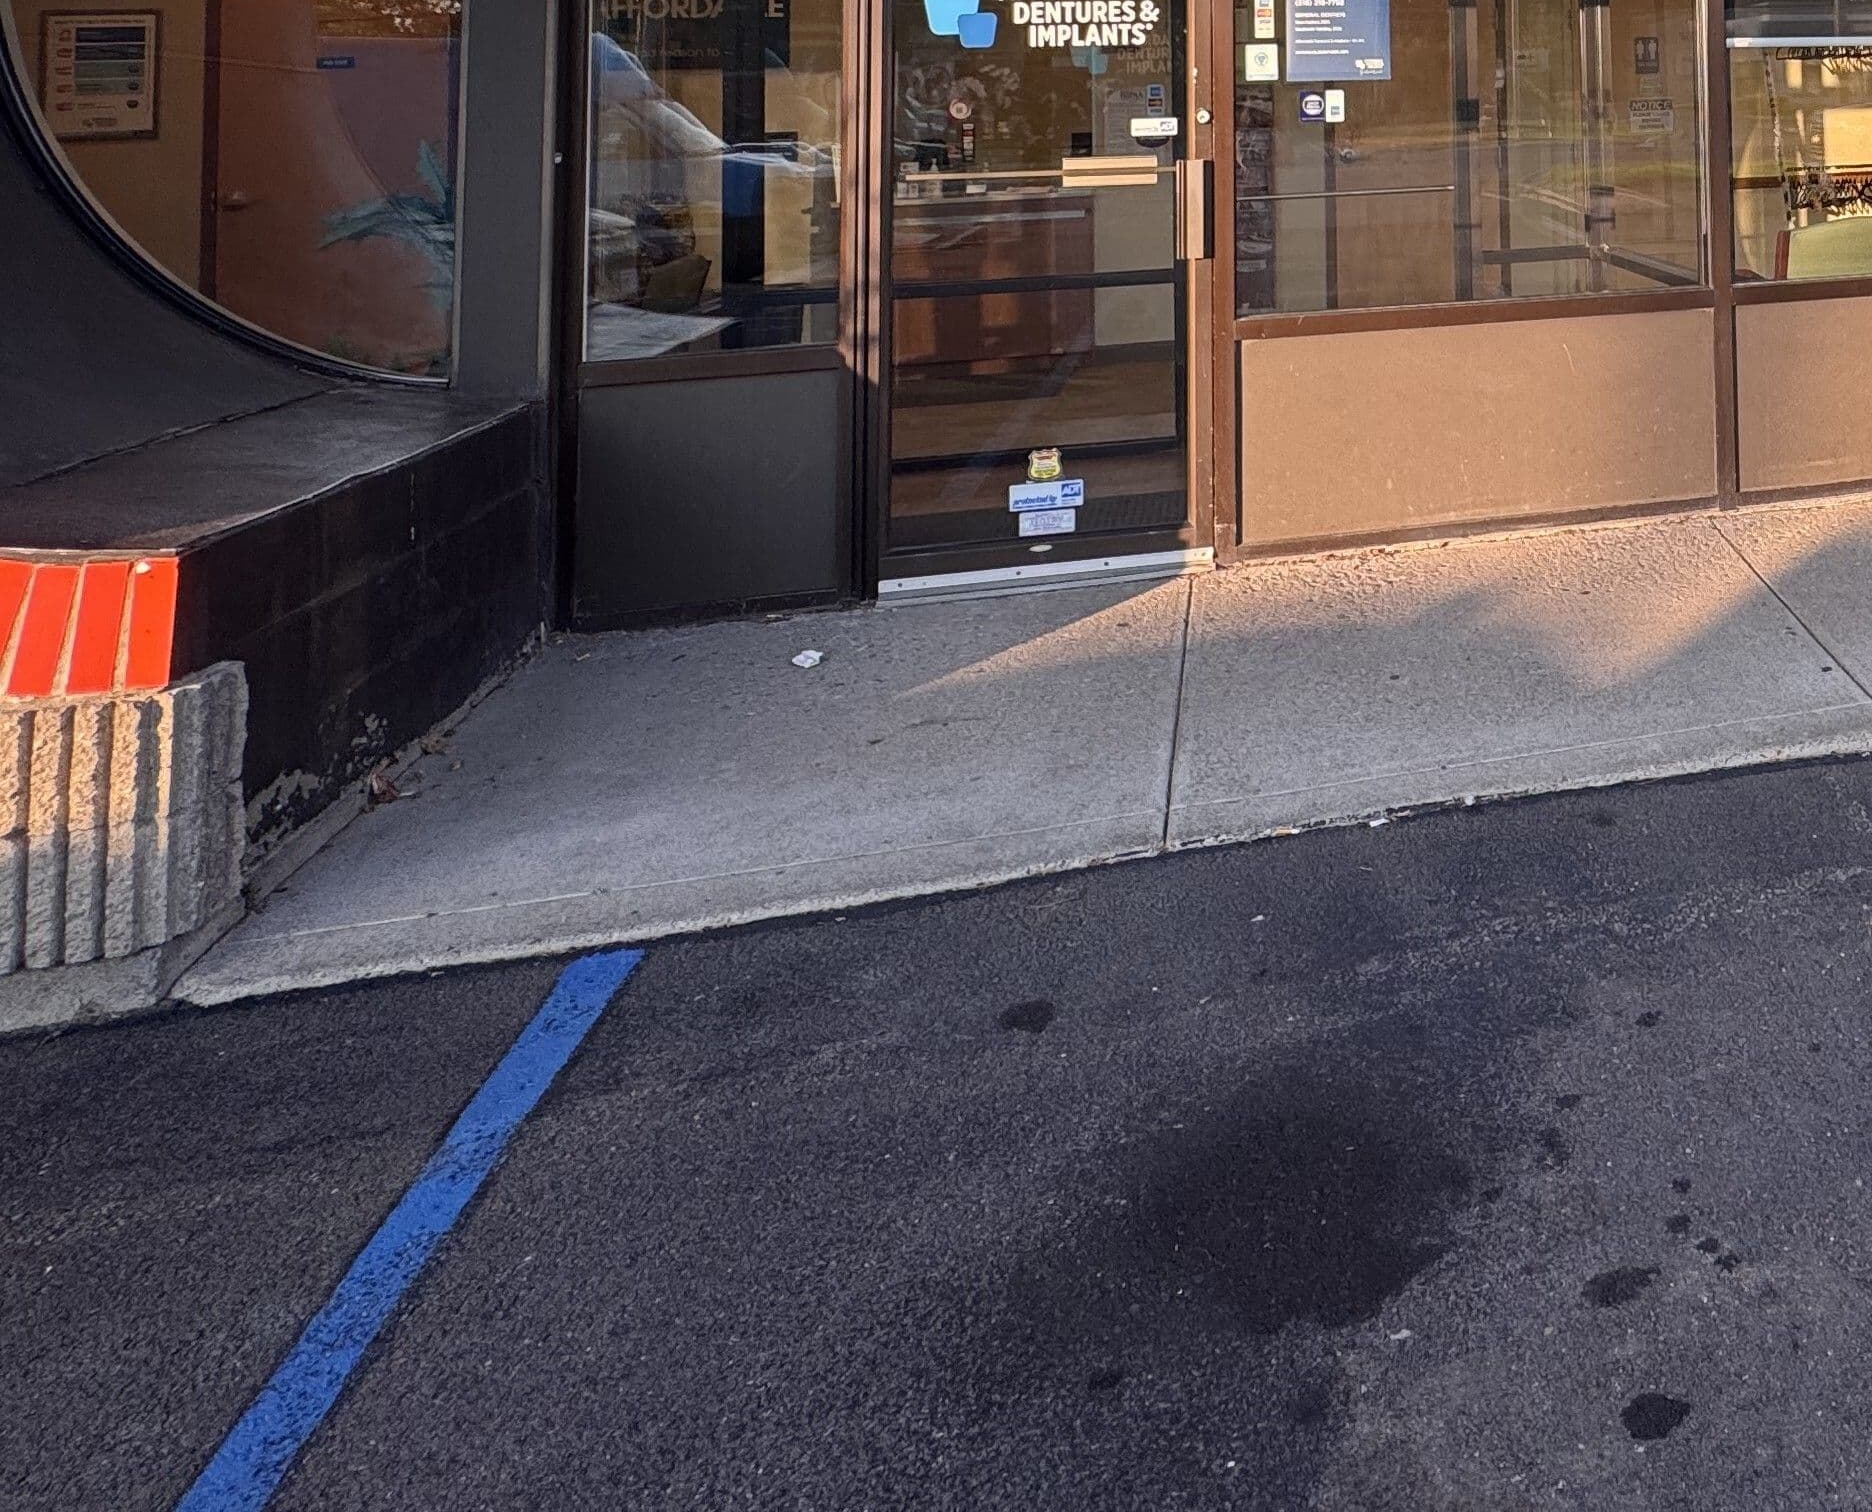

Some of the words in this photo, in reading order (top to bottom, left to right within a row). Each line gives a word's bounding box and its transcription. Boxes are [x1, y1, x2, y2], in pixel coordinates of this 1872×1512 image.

[1012, 0, 1137, 25] DENTURES
[1138, 0, 1161, 23] &
[1631, 100, 1672, 110] NOTICE
[1061, 484, 1081, 496] ADT
